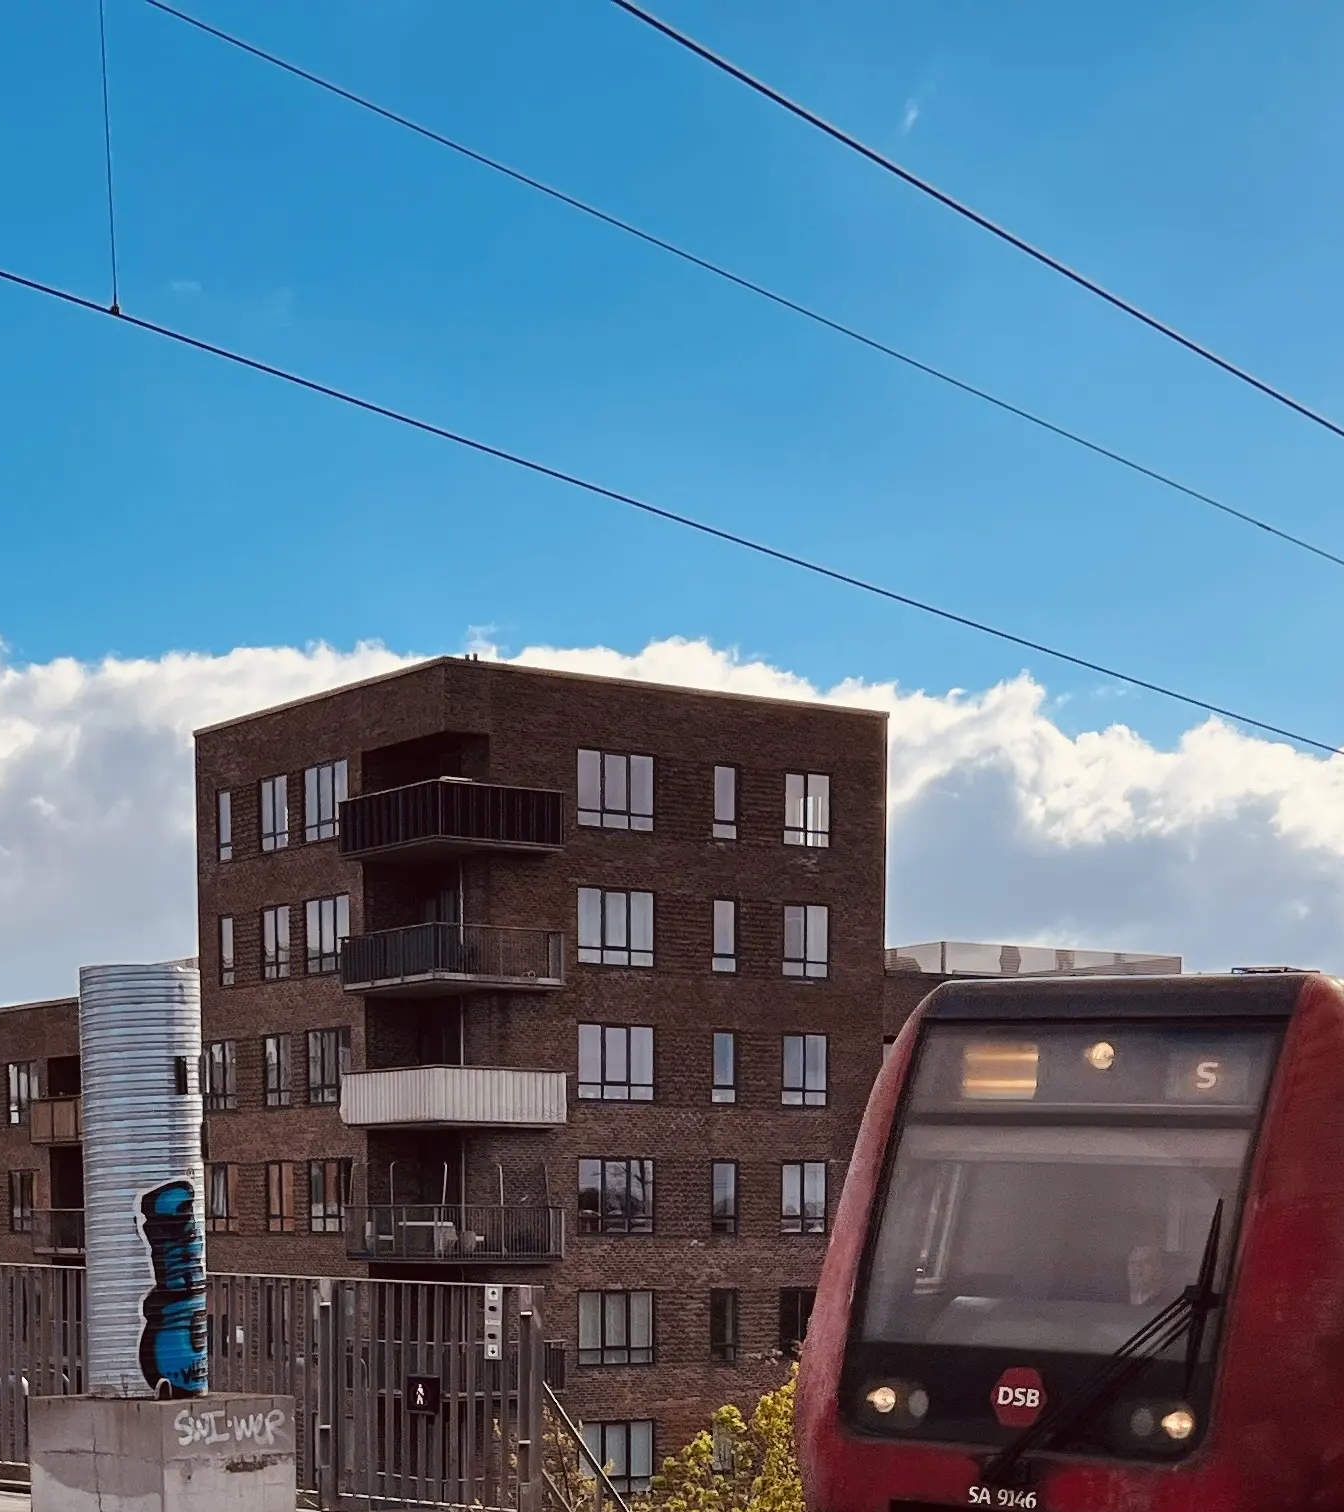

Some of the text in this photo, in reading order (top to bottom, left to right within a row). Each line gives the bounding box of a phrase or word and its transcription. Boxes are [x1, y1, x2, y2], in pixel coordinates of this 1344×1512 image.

[1196, 1061, 1219, 1089] S
[997, 1386, 1040, 1408] DSB
[968, 1486, 1037, 1509] SA 9146
